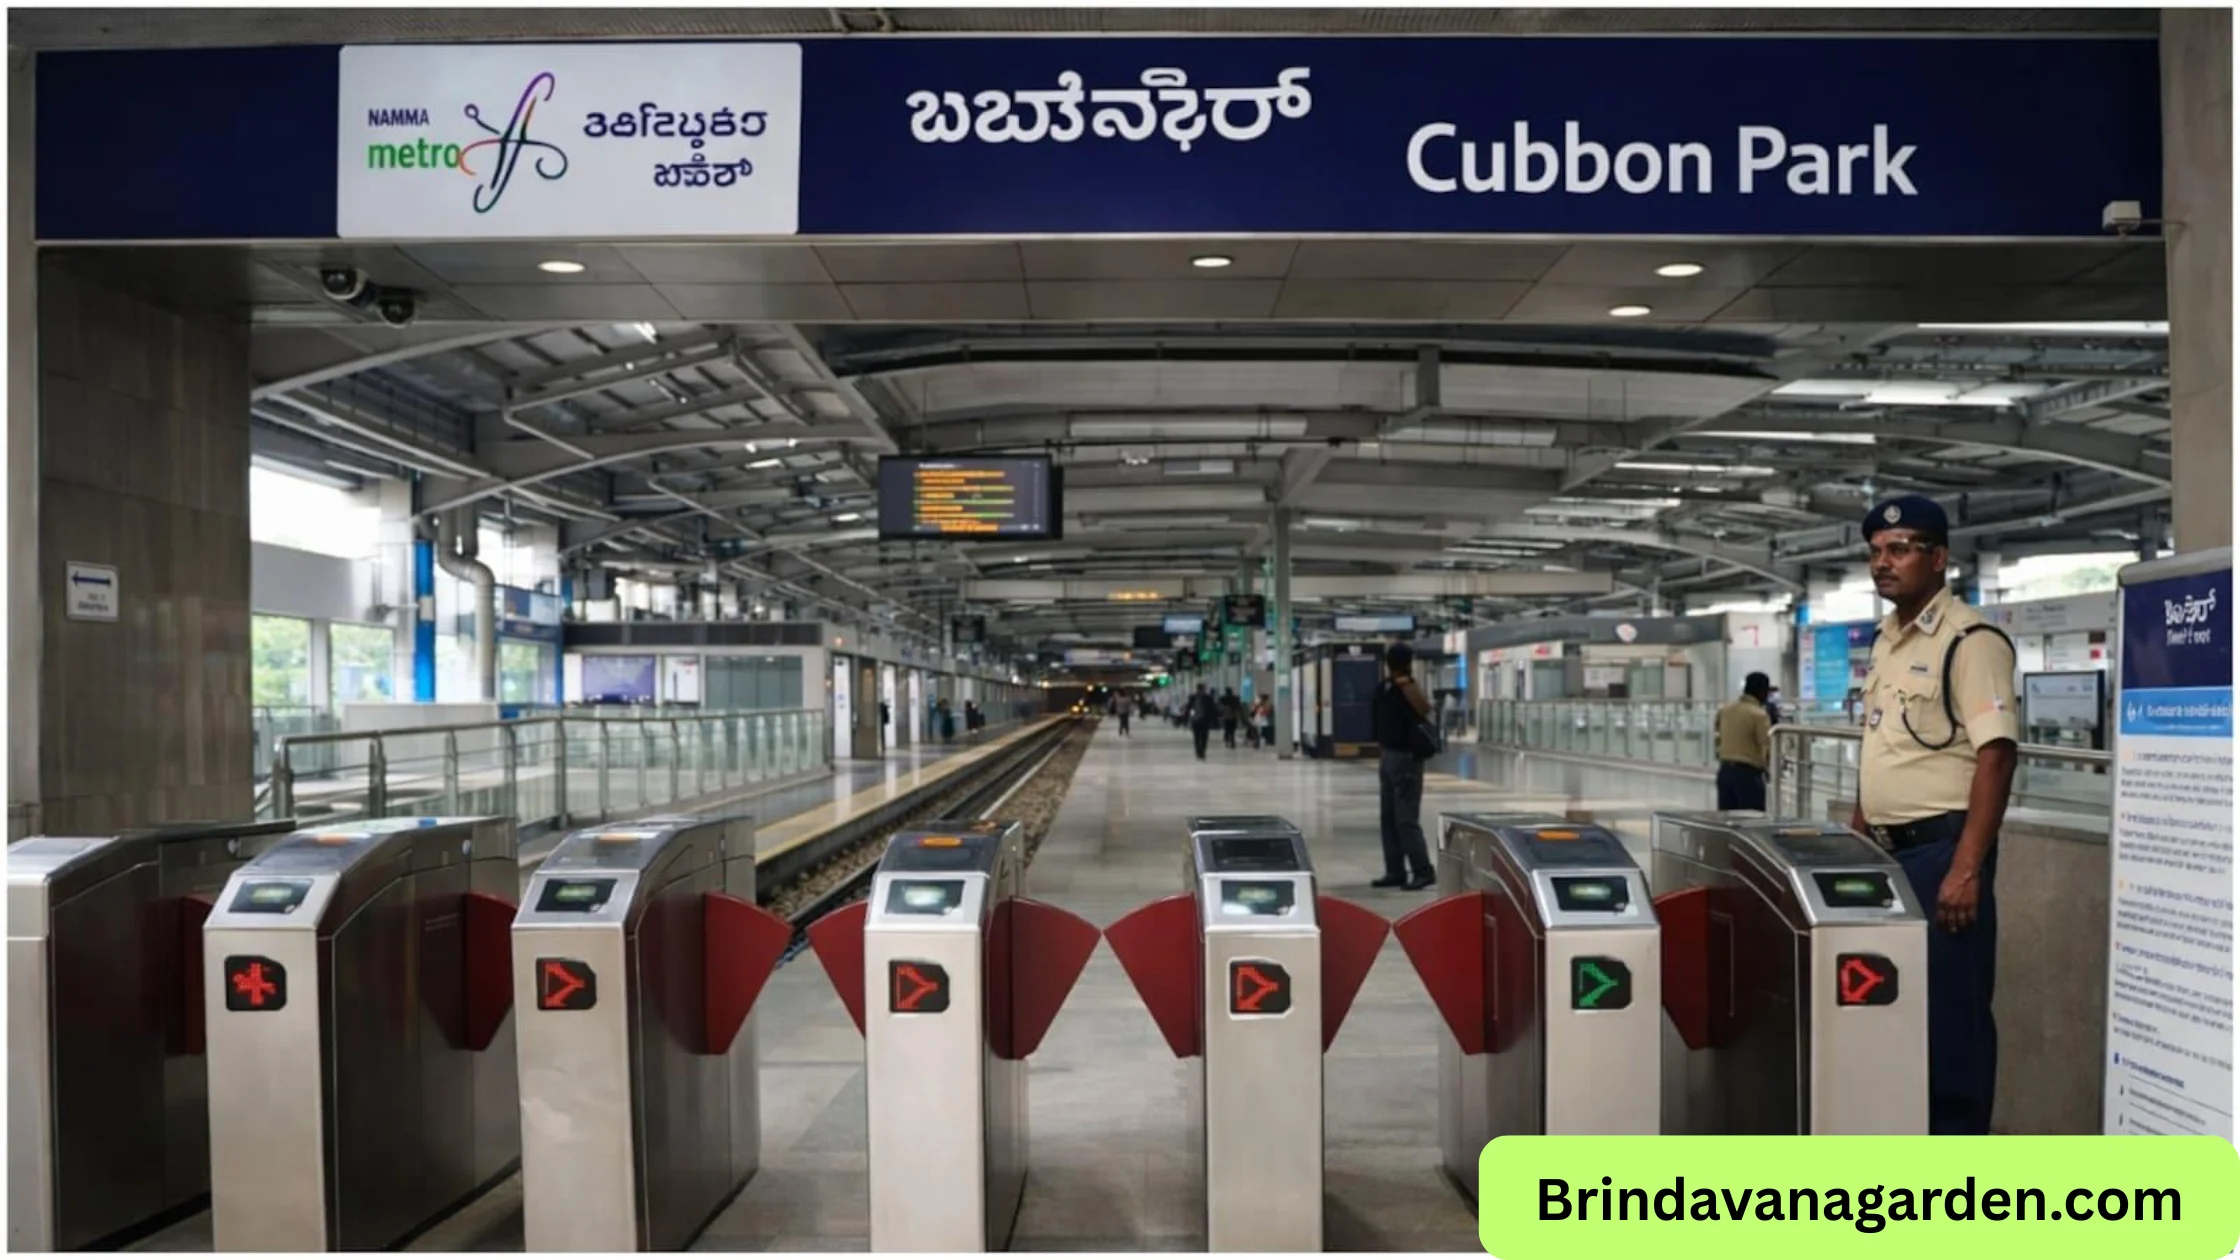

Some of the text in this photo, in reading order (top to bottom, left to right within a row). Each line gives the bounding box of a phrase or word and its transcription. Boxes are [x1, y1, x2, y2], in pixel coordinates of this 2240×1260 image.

[368, 108, 430, 127] NAMMA
[368, 138, 460, 169] metro
[1407, 121, 1918, 195] Cubbon Park
